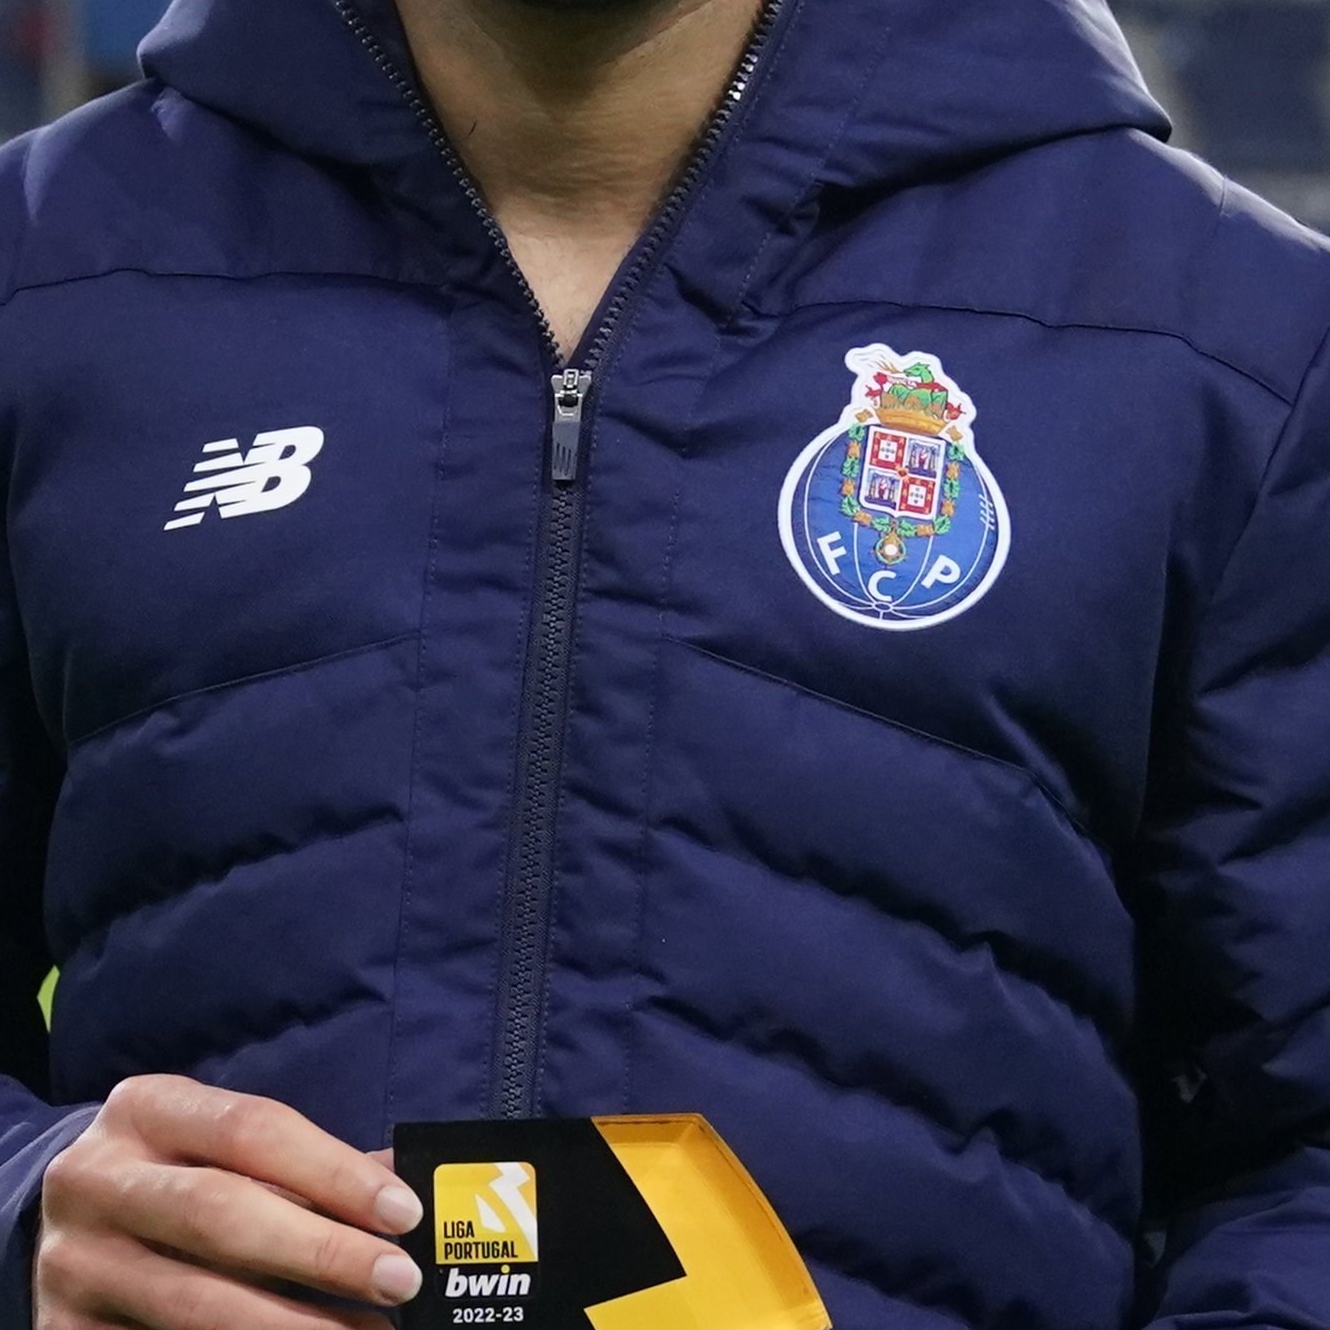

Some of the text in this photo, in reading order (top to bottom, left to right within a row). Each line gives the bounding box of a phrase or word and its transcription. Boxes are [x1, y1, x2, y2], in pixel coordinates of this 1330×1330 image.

[443, 1220, 475, 1239] LIGA
[444, 1240, 518, 1260] PORTUGAL
[445, 1264, 532, 1298] bwin
[452, 1306, 524, 1324] 2022-23
